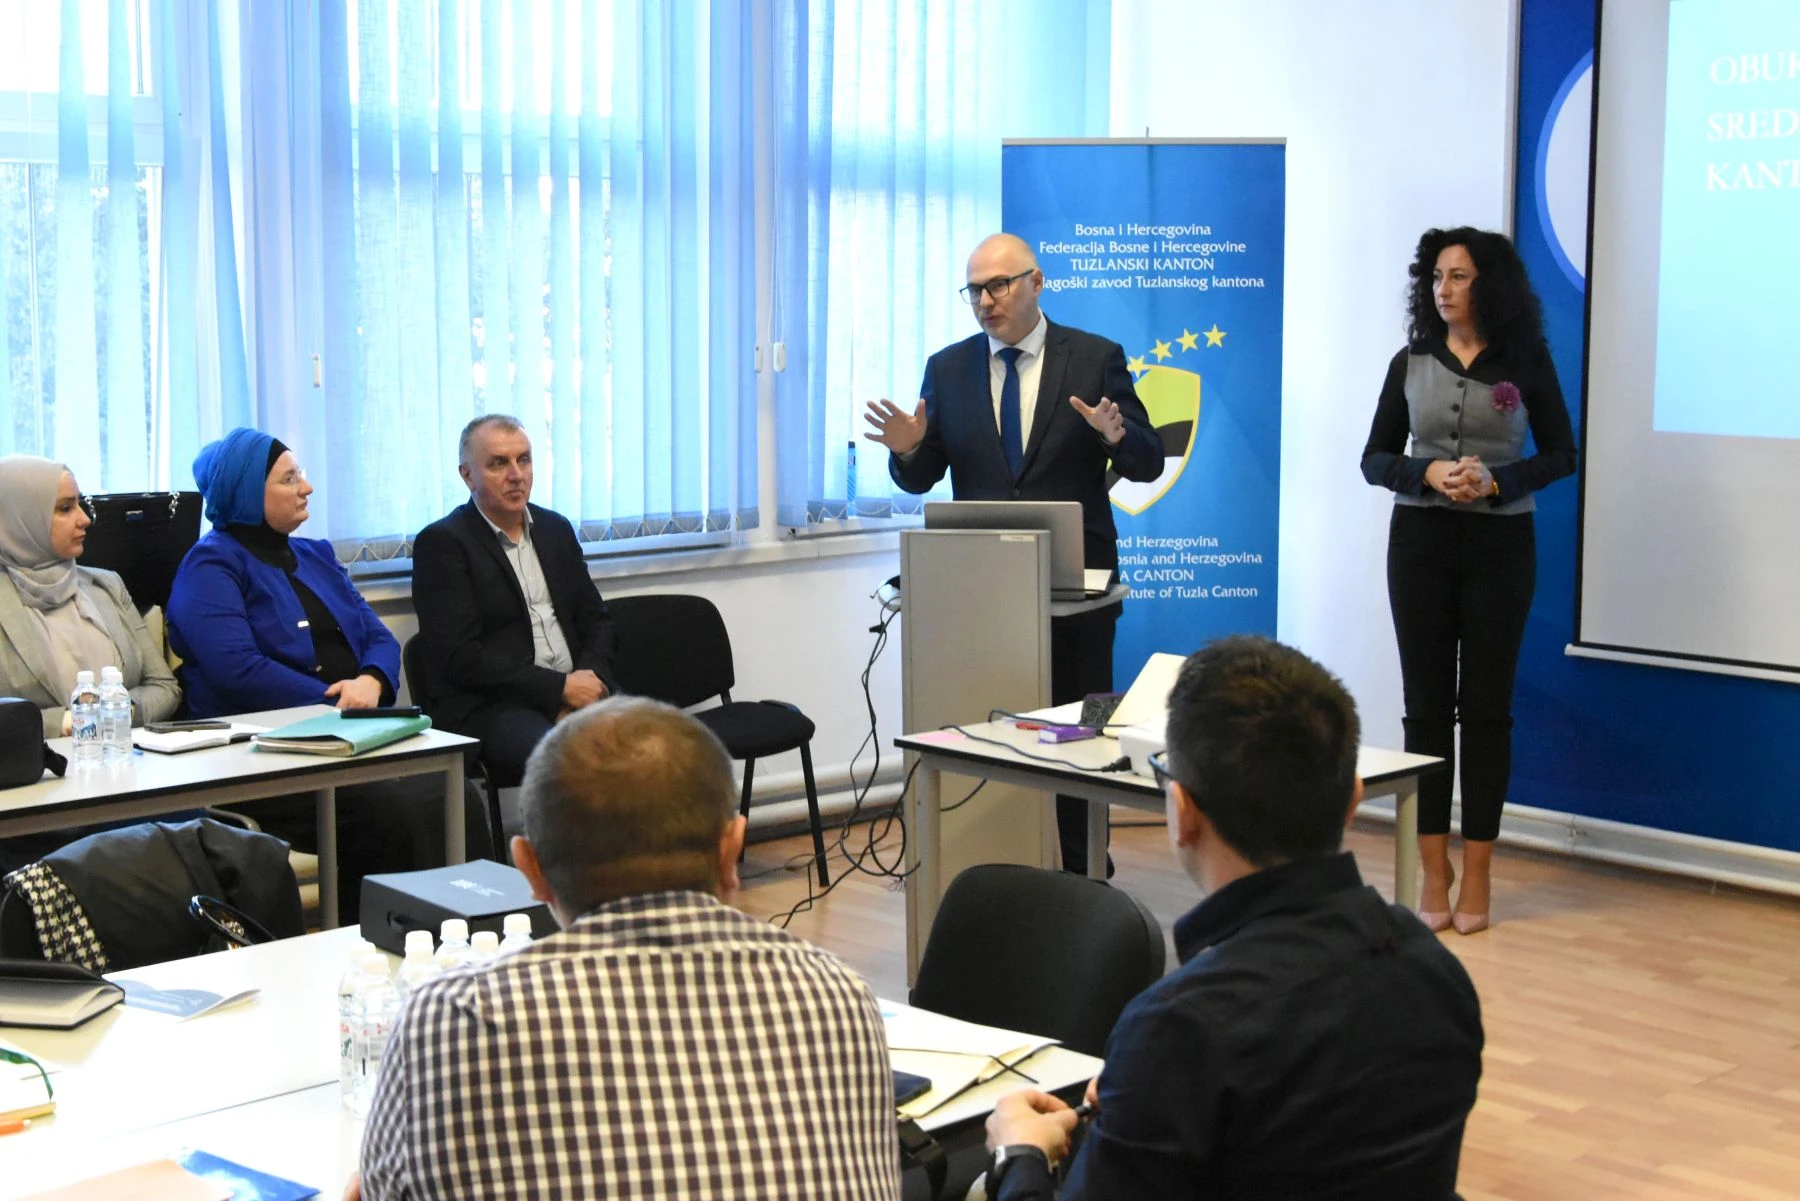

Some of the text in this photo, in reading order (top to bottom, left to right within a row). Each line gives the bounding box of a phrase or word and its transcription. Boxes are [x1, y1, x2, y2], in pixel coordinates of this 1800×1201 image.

[1706, 108, 1800, 142] SRED
[1075, 223, 1115, 236] Bosna
[1127, 223, 1212, 239] Hercegovina
[1039, 240, 1105, 255] Federacija
[1109, 241, 1150, 253] Bosne
[1161, 240, 1247, 256] Hercegovine
[1070, 258, 1215, 271] TUZLANSKI KANTON
[1042, 275, 1265, 292] agoški zavod Tuzlanskog kantona
[1116, 535, 1219, 550] nd Herzegovina
[1118, 552, 1262, 567] osnia and Herzegovina
[1133, 569, 1195, 582] CANTON
[1159, 586, 1174, 599] of
[1176, 586, 1209, 599] Tuzla
[1211, 585, 1258, 598] Canton
